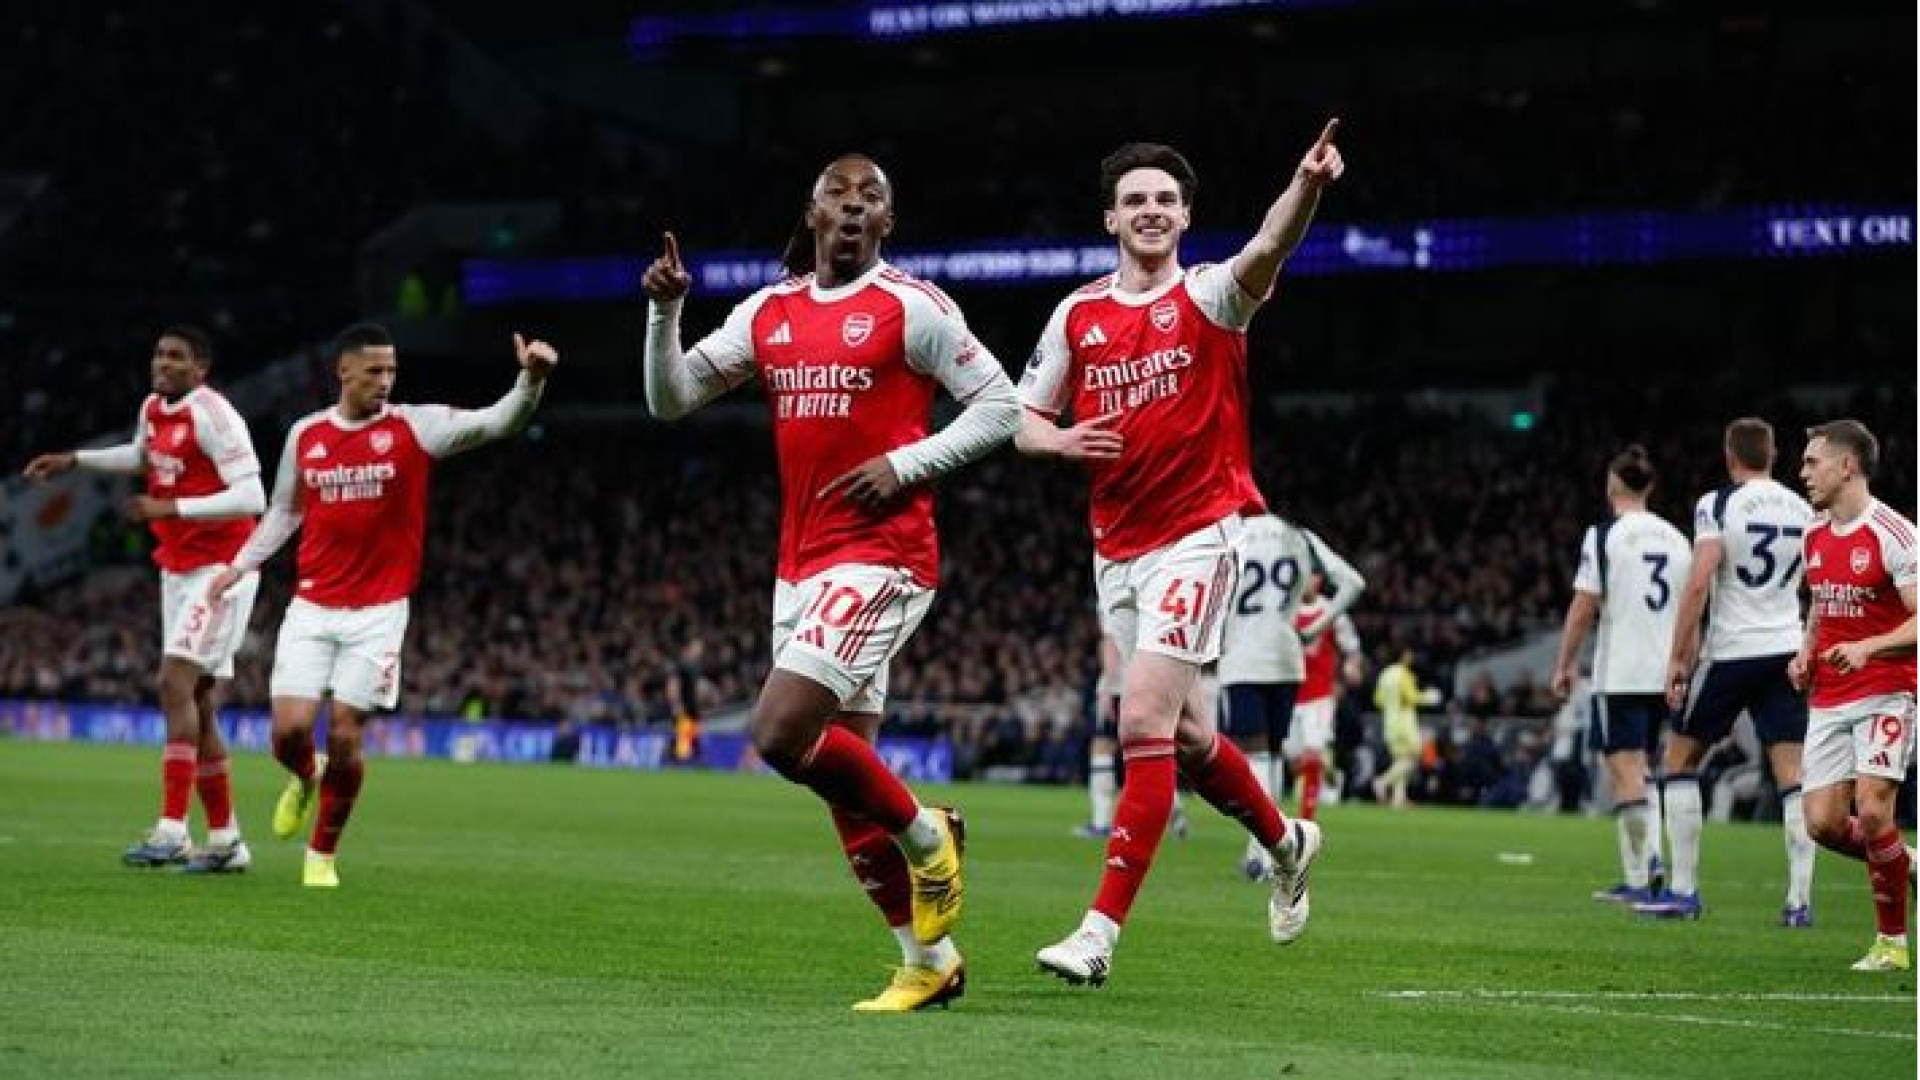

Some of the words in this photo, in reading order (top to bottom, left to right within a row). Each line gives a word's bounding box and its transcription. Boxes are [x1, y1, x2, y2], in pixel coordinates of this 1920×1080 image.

[1772, 219, 1851, 247] TEXT
[1861, 216, 1910, 244] OR
[764, 360, 874, 390] Emirates
[1085, 345, 1193, 391] Emirates
[796, 393, 852, 419] BETTER
[1127, 373, 1178, 408] BETTER
[1736, 523, 1803, 589] 37
[1159, 578, 1205, 625] 41
[1237, 557, 1299, 614] 29
[1642, 553, 1670, 612] 3
[1810, 579, 1877, 602] mirates
[803, 581, 865, 628] 10
[1868, 713, 1903, 747] 19
